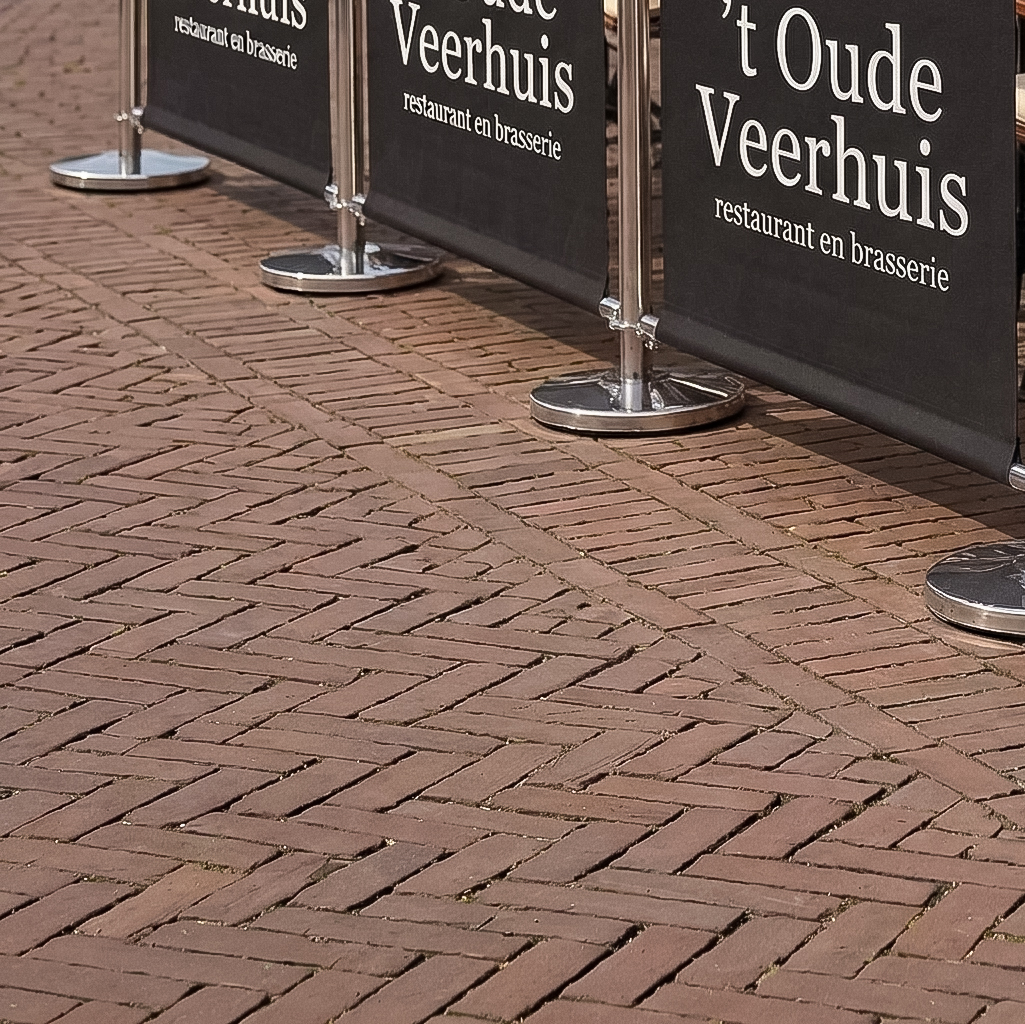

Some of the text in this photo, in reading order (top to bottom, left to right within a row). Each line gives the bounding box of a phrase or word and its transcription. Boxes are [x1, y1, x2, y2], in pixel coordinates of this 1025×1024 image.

[777, 8, 942, 122] Oude
[404, 93, 561, 160] restaurant en brasserie
[696, 84, 968, 236] Veerhuis
[715, 198, 949, 291] restaurant en brasserie
